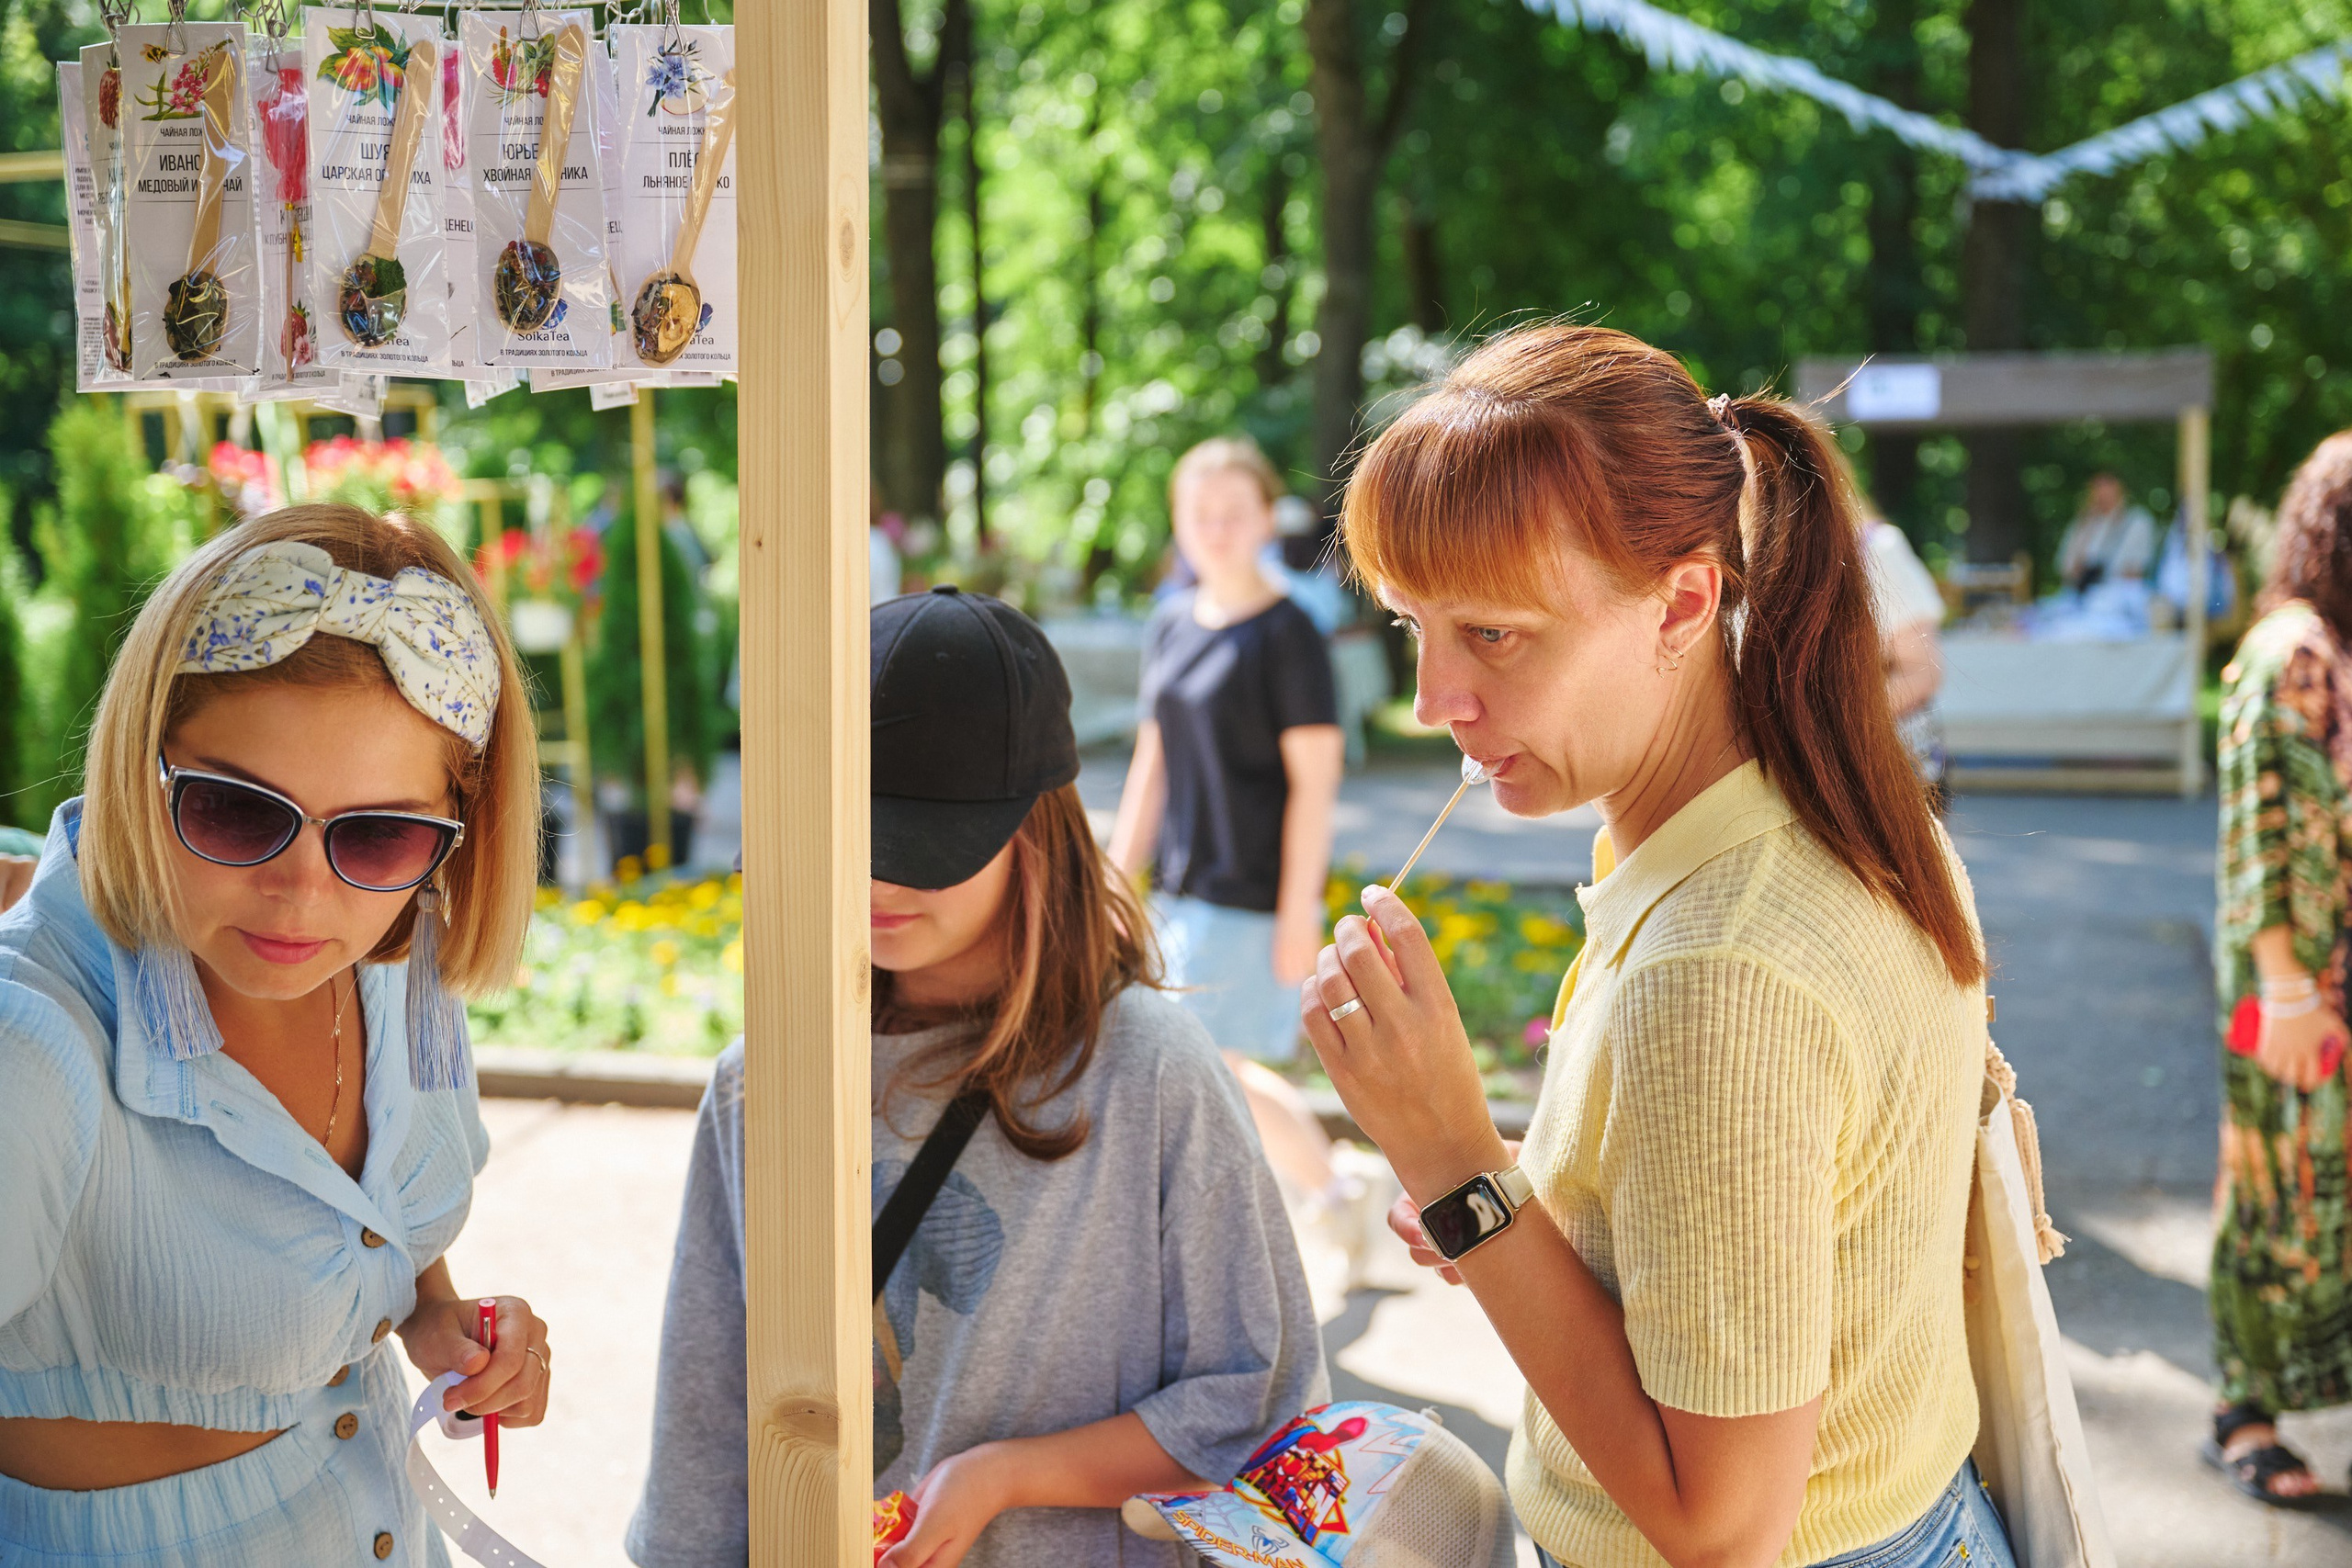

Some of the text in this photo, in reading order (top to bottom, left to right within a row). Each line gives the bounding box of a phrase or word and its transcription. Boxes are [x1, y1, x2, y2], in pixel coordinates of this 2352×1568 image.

[346, 114, 396, 127] ЧАЙНАЯ ЛОЖ
[504, 116, 533, 126] ЧАЙНАЯ
[160, 127, 202, 137] ЧАЙНАЯ ЛОЖ
[658, 125, 705, 136] ЧАЙНАЯ ЛОЖ
[503, 143, 539, 161] ЮРЬЕ
[159, 154, 200, 172] ИВАНО
[322, 165, 372, 181] ЦАРСКАЯ
[483, 166, 532, 182] ХВОЙНАЯ
[138, 177, 189, 194] МЕДОВЫЙ
[642, 175, 688, 188] ЛЬНЯНОЕ
[517, 331, 570, 342] SoikaTea
[346, 351, 379, 359] ТРАДИЦИЯХ
[1172, 1509, 1308, 1568] SPIDER-MAN
